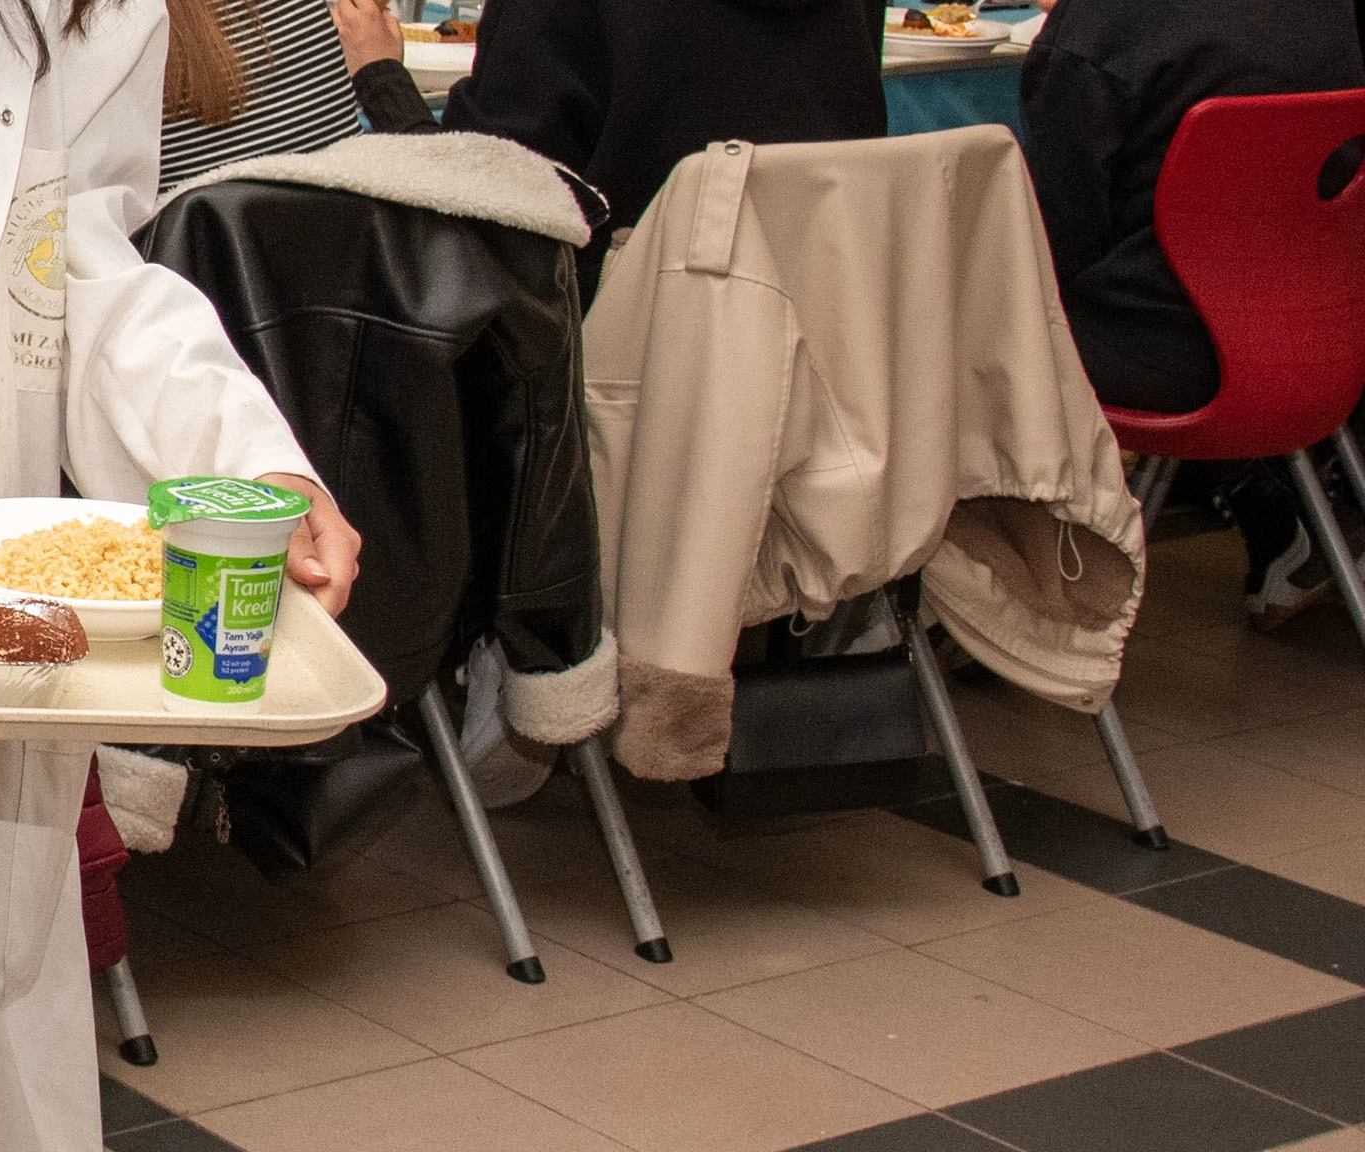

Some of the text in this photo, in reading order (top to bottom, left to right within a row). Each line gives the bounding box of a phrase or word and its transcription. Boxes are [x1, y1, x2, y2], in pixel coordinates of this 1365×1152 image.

[230, 578, 278, 597] Tarım
[232, 596, 273, 617] Kredi
[224, 632, 244, 641] Tam
[222, 643, 249, 654] Ayran
